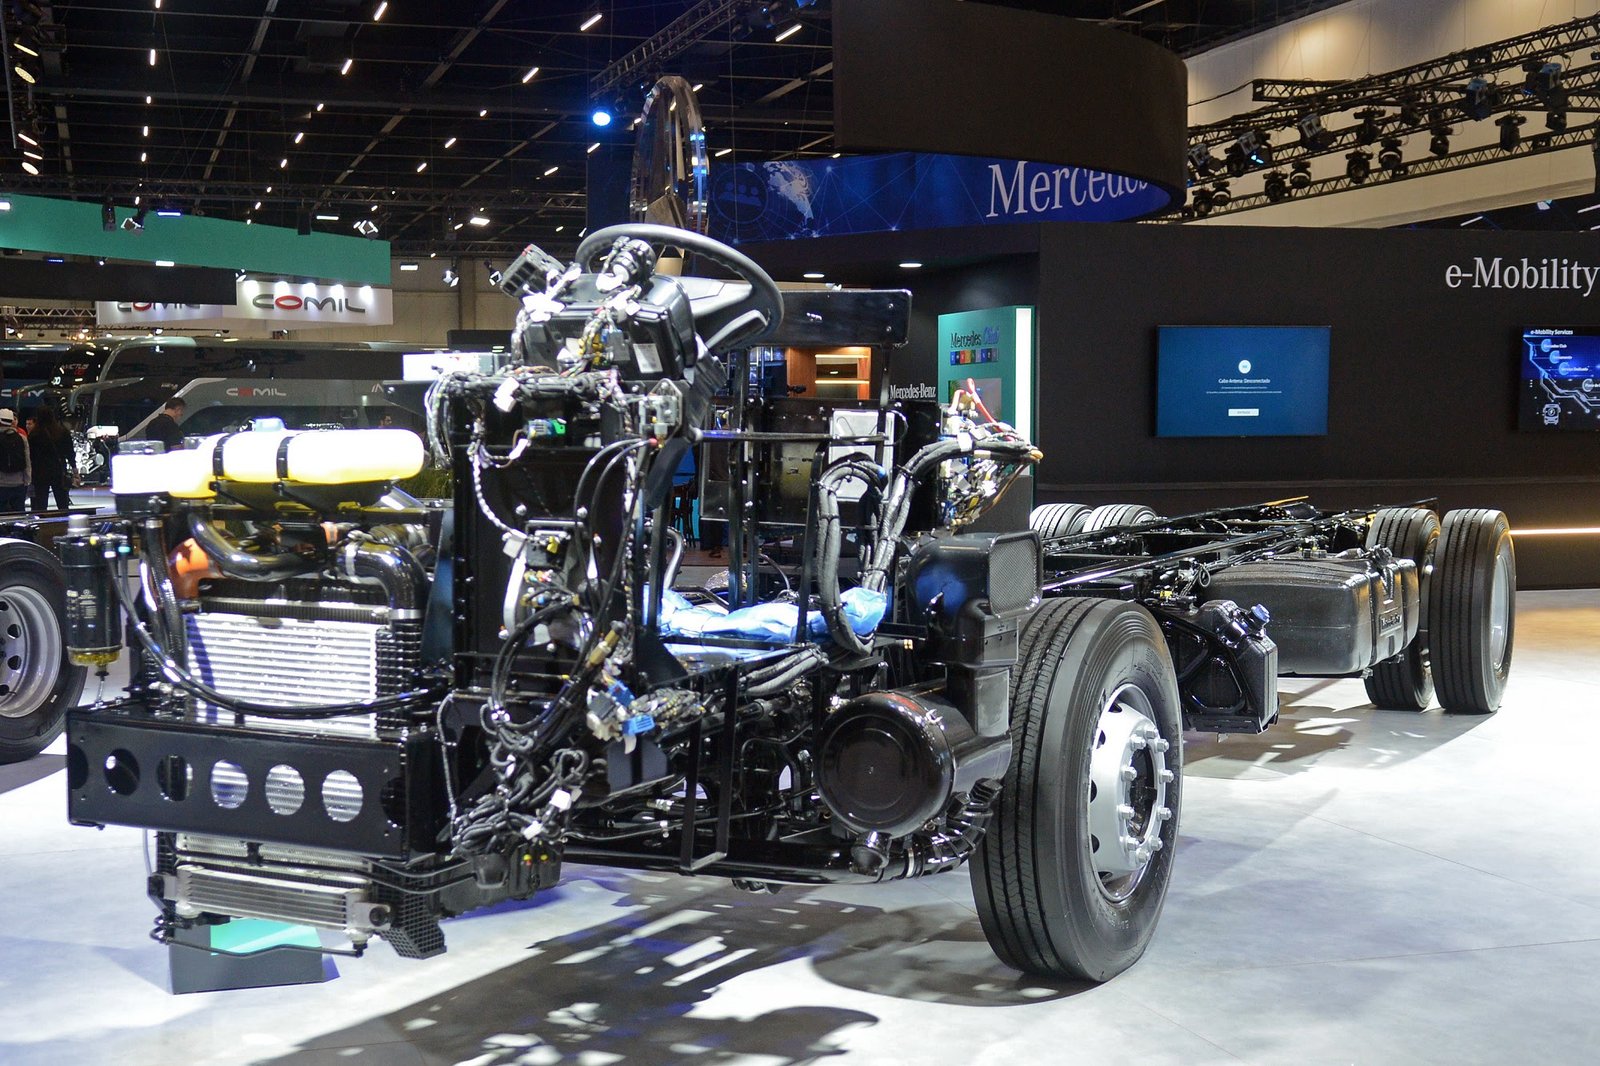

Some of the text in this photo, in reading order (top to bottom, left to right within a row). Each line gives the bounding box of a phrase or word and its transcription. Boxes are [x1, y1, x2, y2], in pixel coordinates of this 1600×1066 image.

[1445, 257, 1600, 297] e-Mobility
[252, 294, 365, 313] COMIL
[950, 331, 981, 348] Mercedes
[890, 383, 936, 399] Mercedes-Benz
